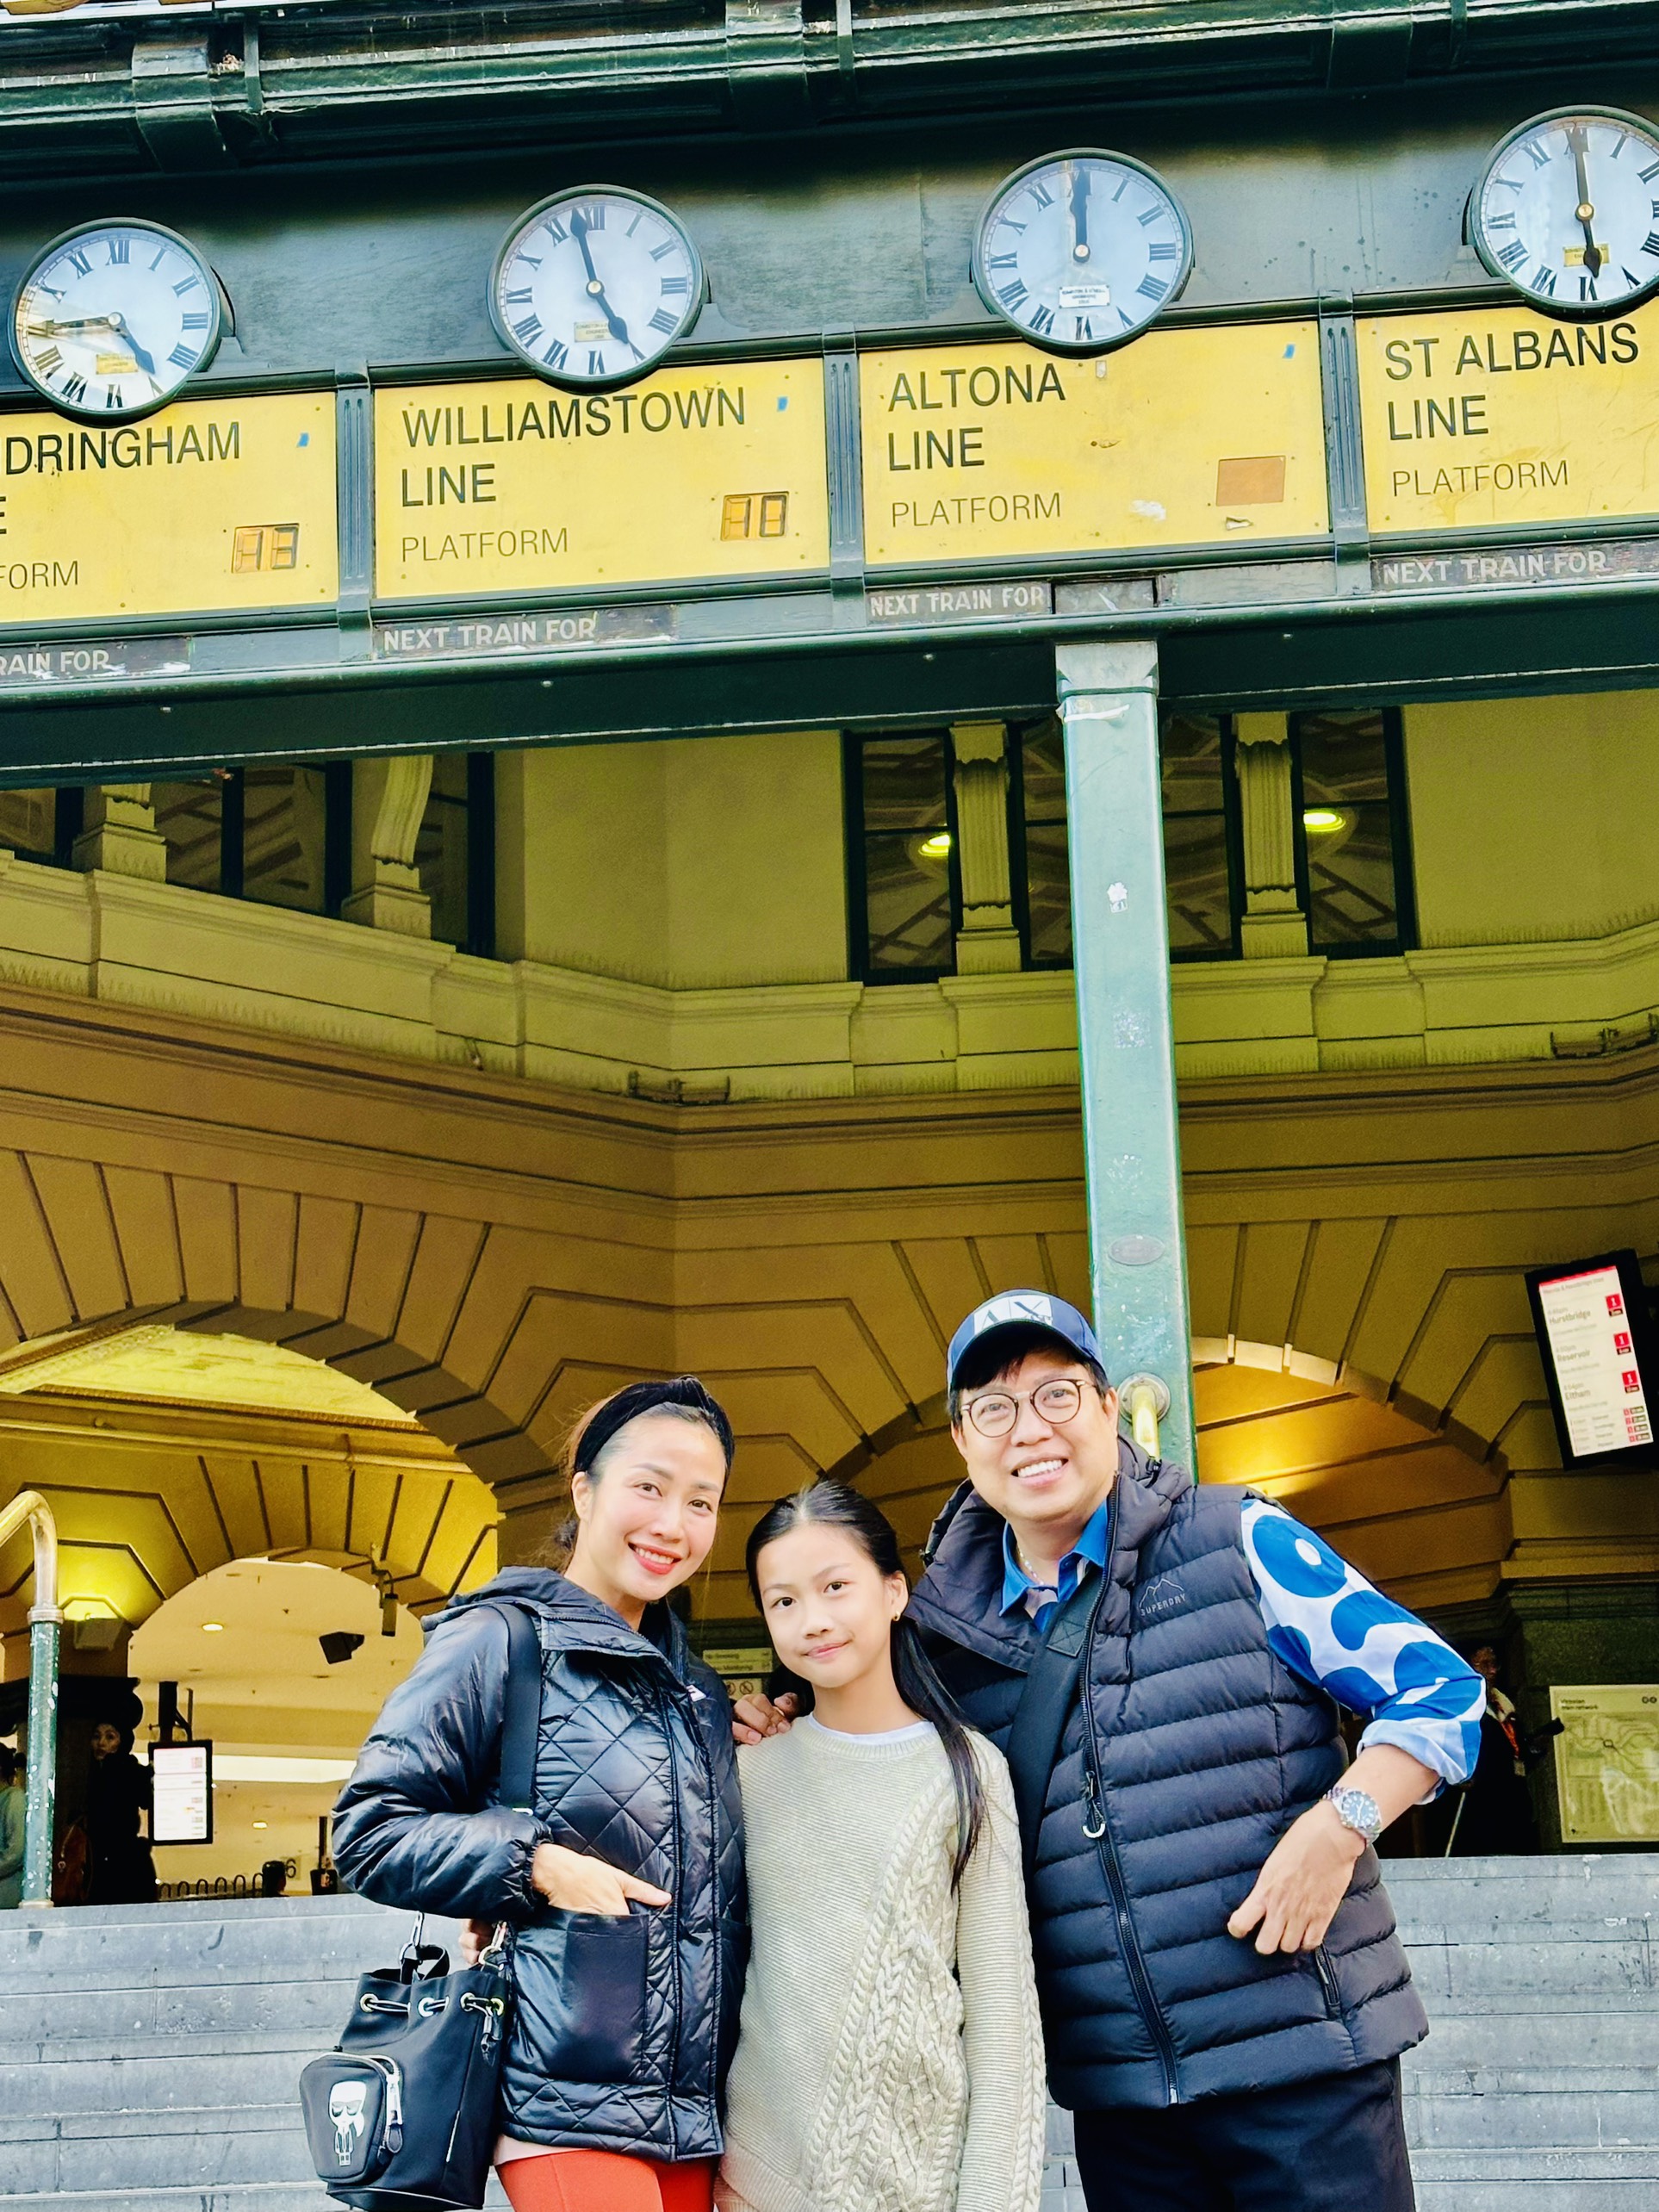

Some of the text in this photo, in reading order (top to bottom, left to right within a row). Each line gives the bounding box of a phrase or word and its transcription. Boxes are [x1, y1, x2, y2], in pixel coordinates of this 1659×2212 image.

[1386, 323, 1639, 380] ST ALBANS
[888, 363, 1066, 412] ALTONA
[402, 387, 745, 447] WILLIAMSTOWN
[1389, 395, 1488, 440] LINE
[6, 422, 239, 475] DRINGHAM
[889, 427, 985, 470] LINE
[401, 463, 497, 507] LINE
[1393, 460, 1569, 496] PLATFORM
[892, 493, 1061, 527] PLATFORM
[402, 528, 568, 562] PLATFORM
[1383, 550, 1608, 584] NEXT TRAIN FOR
[870, 587, 1044, 617] NEXT TRAIN FOR
[384, 618, 595, 650] NEXT TRAIN FOR
[59, 649, 110, 672] FOR
